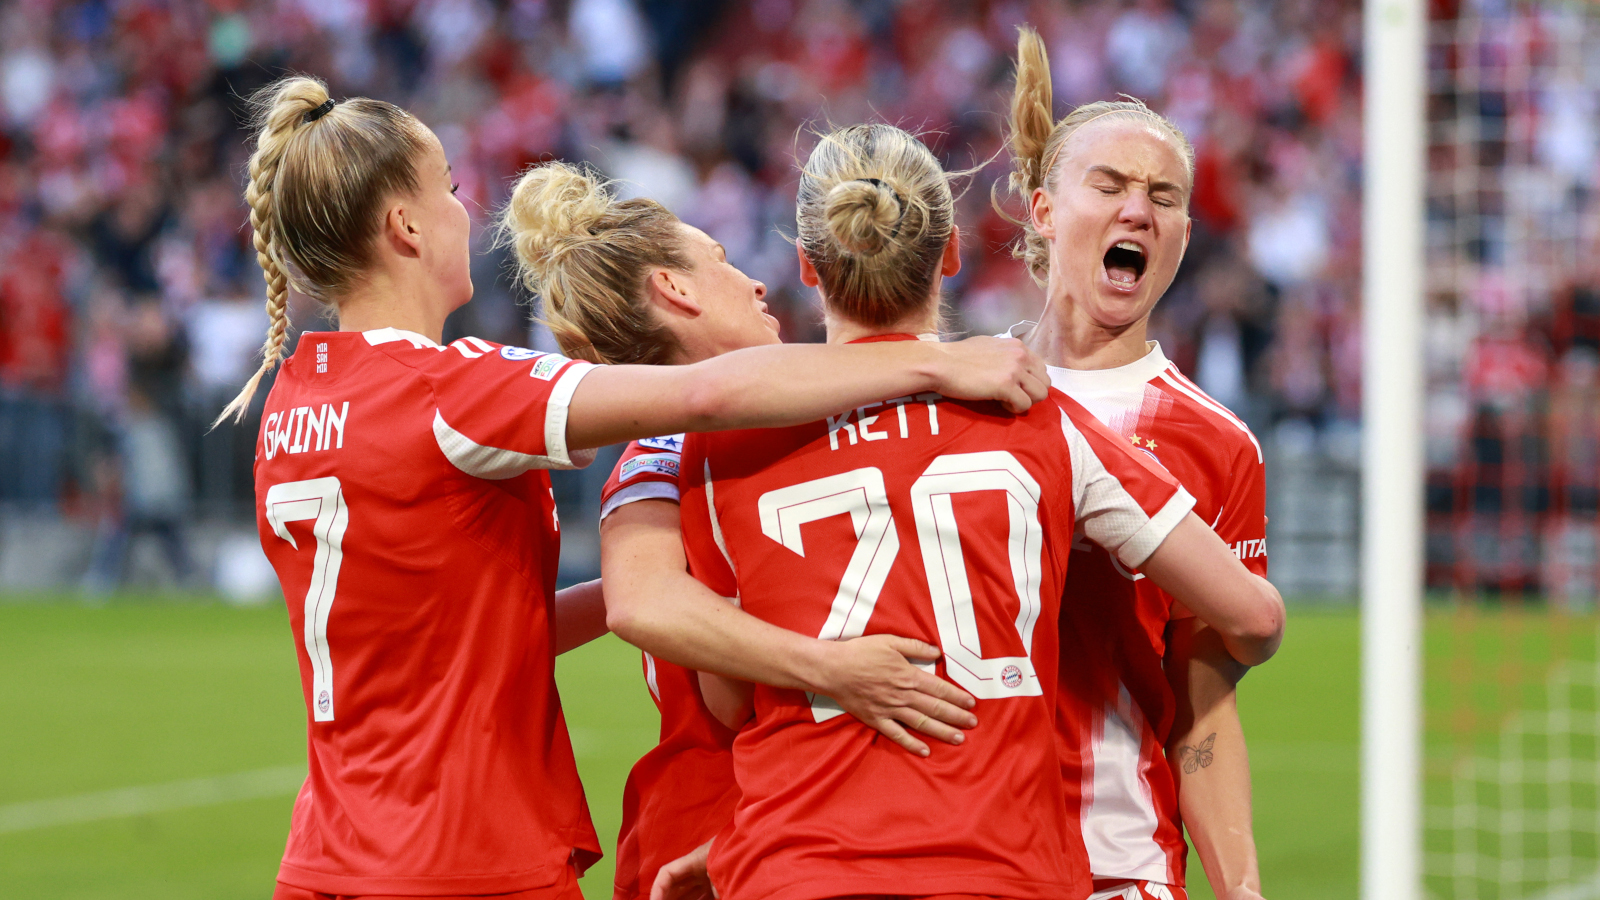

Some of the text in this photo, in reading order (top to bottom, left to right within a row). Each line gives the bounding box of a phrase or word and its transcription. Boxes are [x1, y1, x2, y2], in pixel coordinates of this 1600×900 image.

[316, 343, 328, 353] MIA
[316, 363, 328, 373] MIA
[264, 401, 350, 461] GWINN
[826, 392, 942, 451] KETT
[265, 476, 349, 722] 7
[757, 450, 1043, 724] 20
